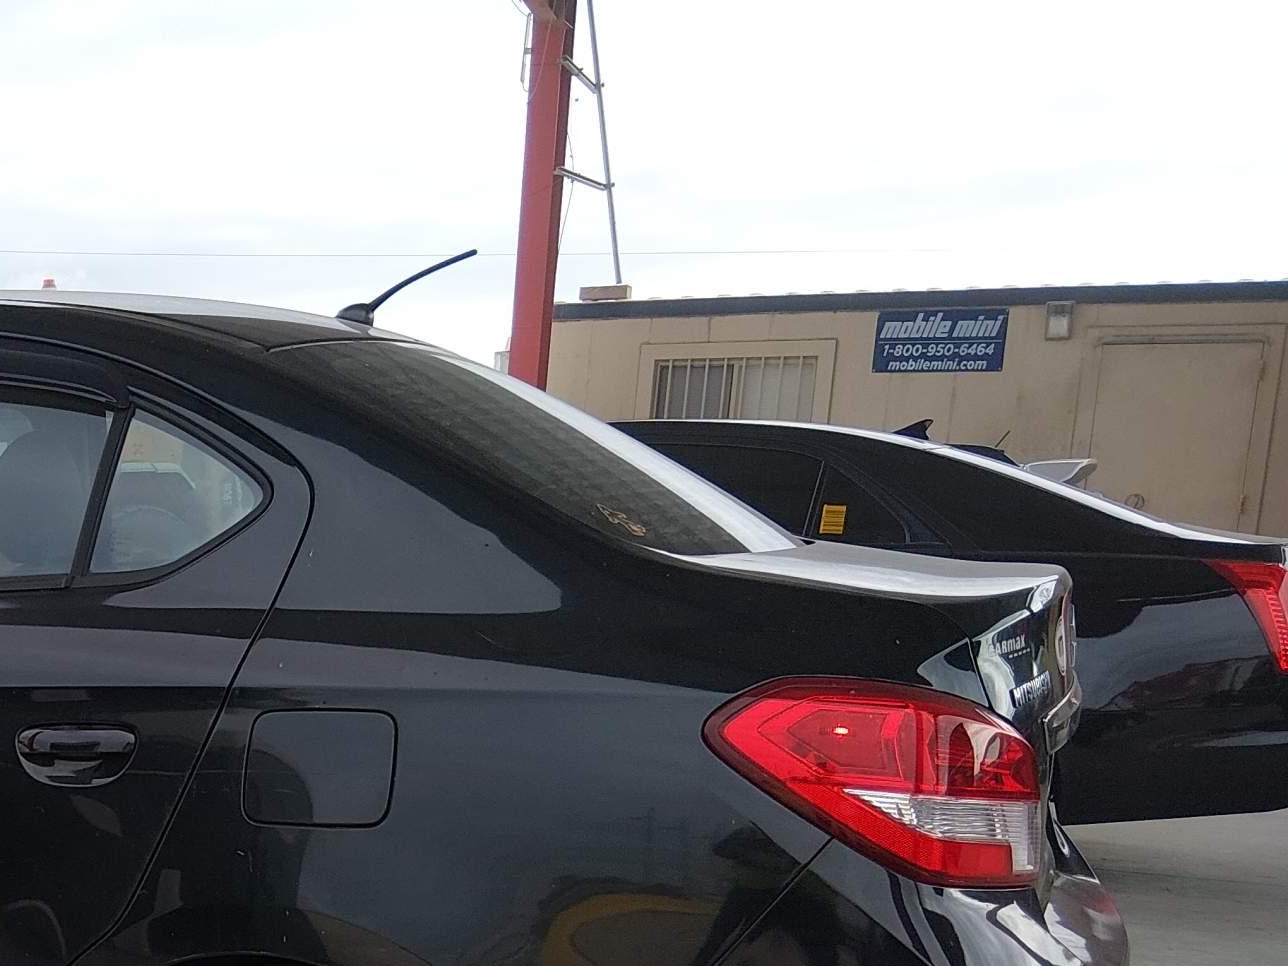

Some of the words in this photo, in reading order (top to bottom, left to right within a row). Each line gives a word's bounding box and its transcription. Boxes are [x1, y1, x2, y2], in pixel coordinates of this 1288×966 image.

[880, 312, 951, 338] mobile
[952, 314, 1006, 338] mini
[882, 343, 995, 357] 1-800-950-6464
[887, 358, 988, 371] mobilemini.com
